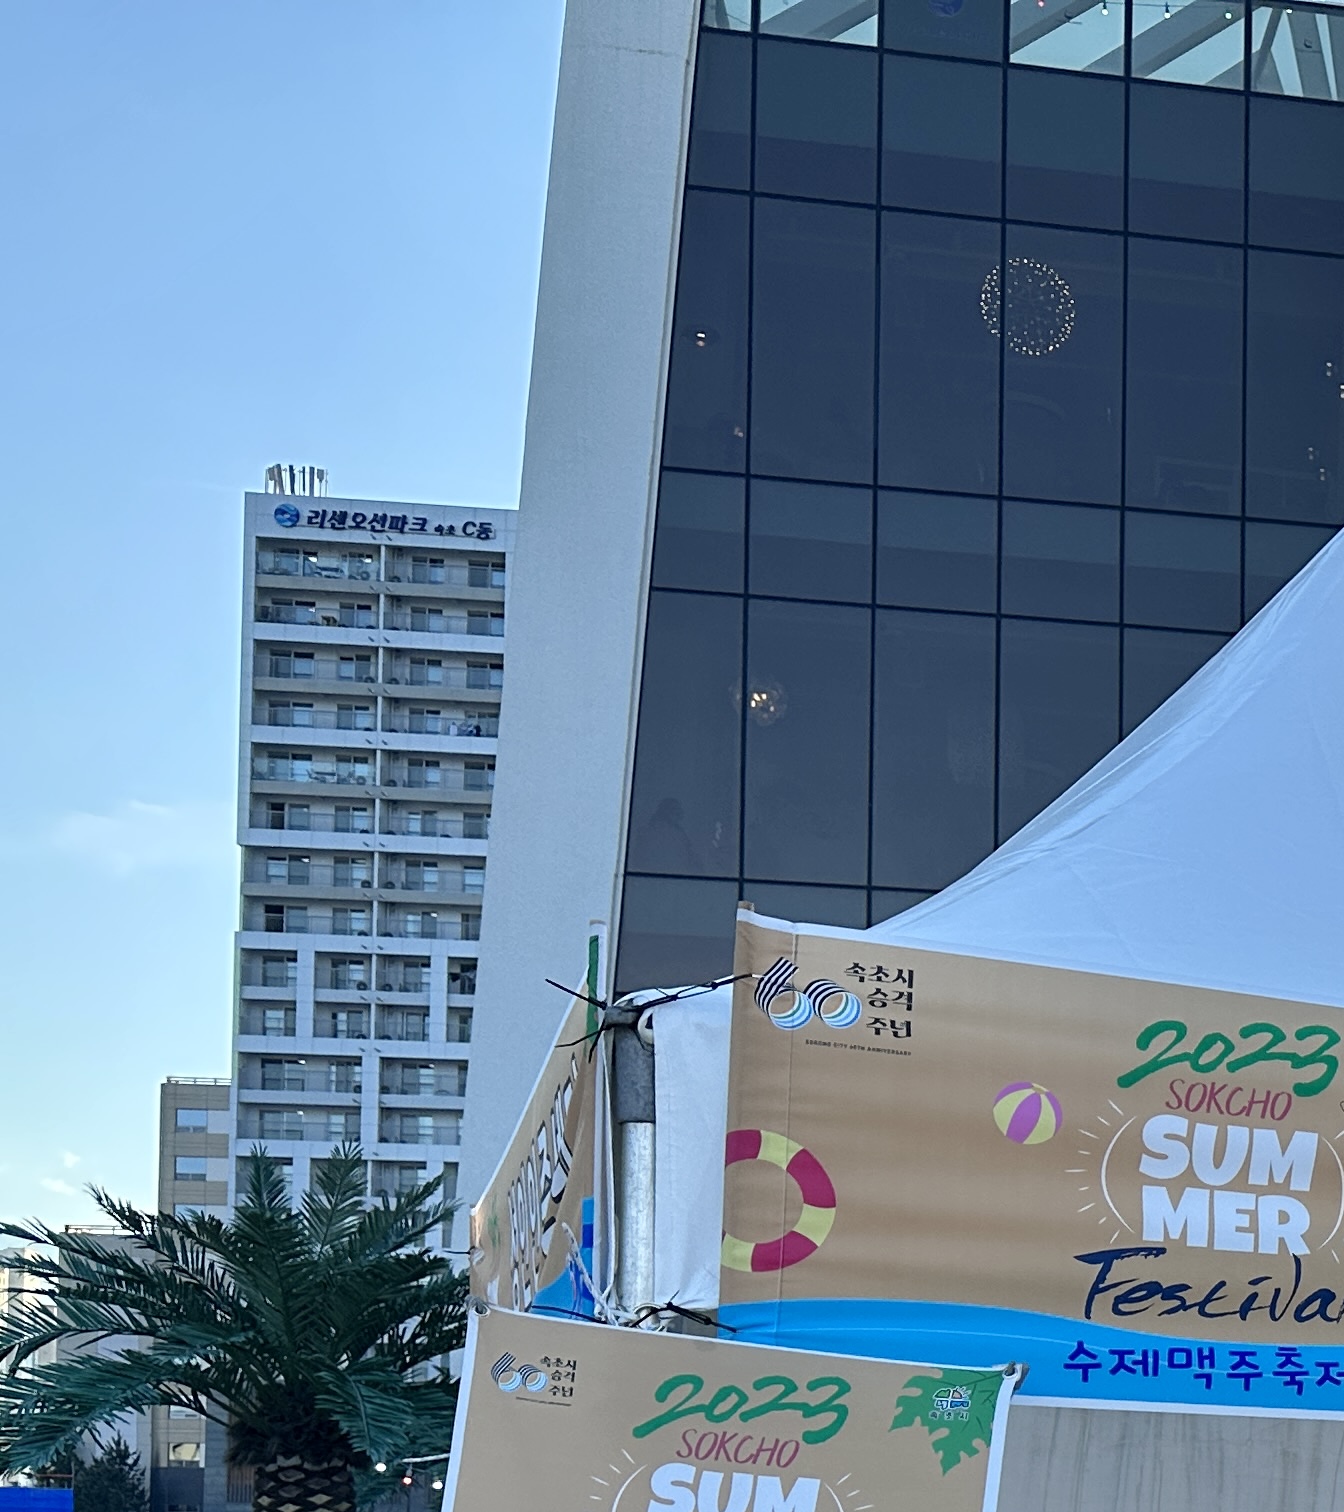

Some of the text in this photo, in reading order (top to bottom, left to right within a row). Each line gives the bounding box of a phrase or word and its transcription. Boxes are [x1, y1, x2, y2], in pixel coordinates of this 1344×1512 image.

[462, 520, 493, 540] C동
[844, 961, 914, 989] 속초시
[866, 987, 913, 1012] 승격
[865, 1016, 912, 1039] 주년
[1117, 1020, 1340, 1097] 2023
[1164, 1079, 1293, 1121] SOKCHO
[1138, 1115, 1318, 1192] SUM
[1139, 1185, 1311, 1257] MER
[632, 1374, 851, 1445] 2023
[676, 1429, 800, 1468] SOKCHO
